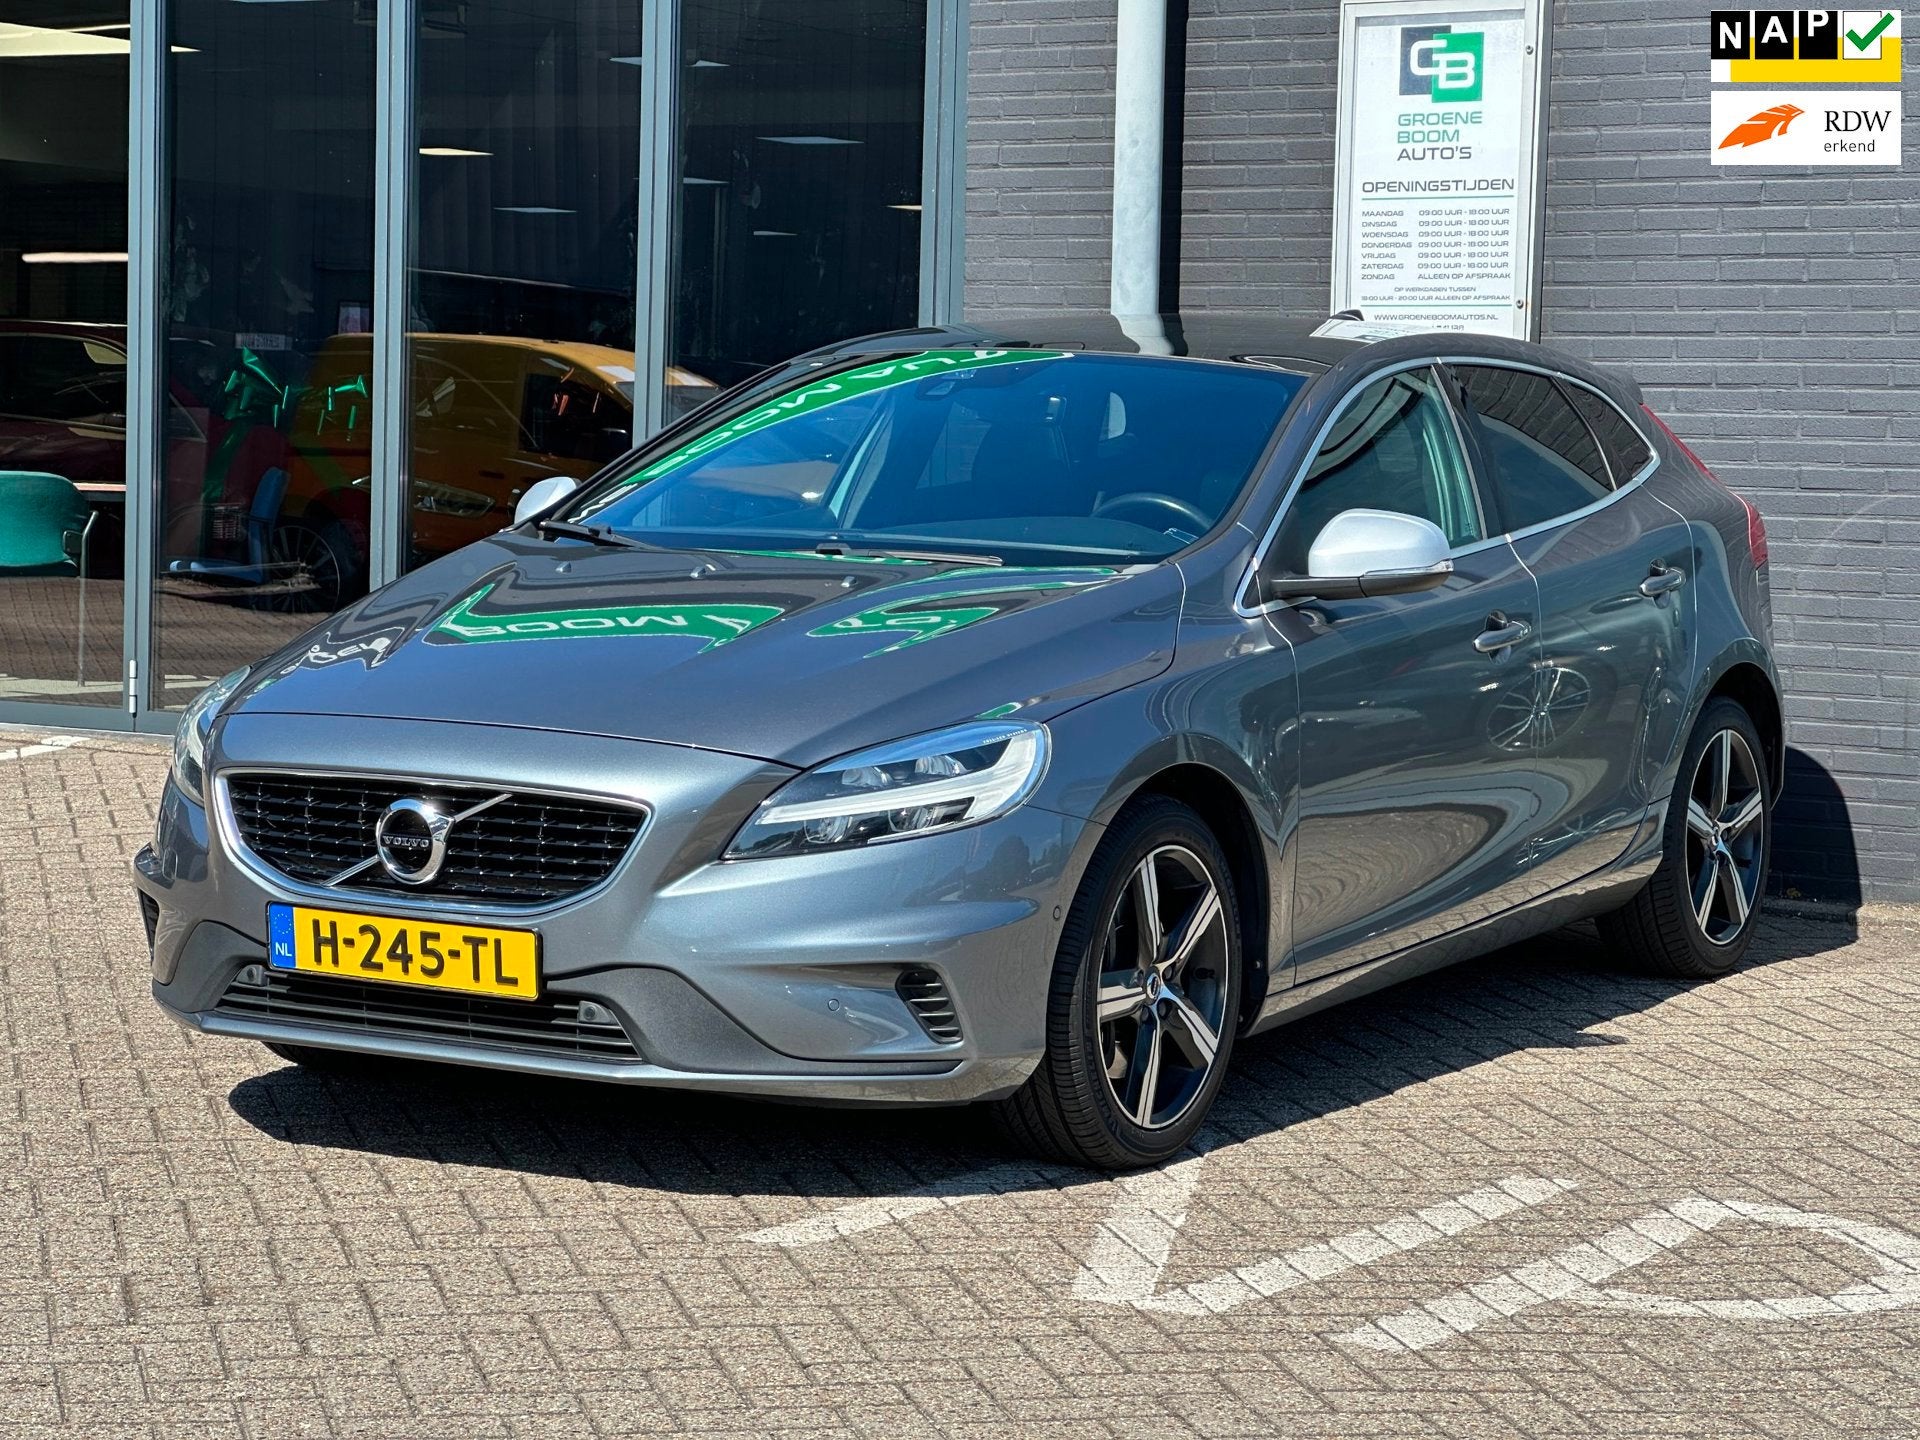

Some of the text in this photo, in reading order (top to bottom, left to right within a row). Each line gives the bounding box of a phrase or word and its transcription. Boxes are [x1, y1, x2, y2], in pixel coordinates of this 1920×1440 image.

[1398, 111, 1482, 126] GROENE
[1397, 130, 1459, 143] BOOM
[1397, 147, 1472, 161] AUTO'S
[1362, 179, 1514, 193] OPENINGSTIJDEN
[382, 835, 430, 848] VOLVO
[275, 918, 519, 987] NL H-245-TL
